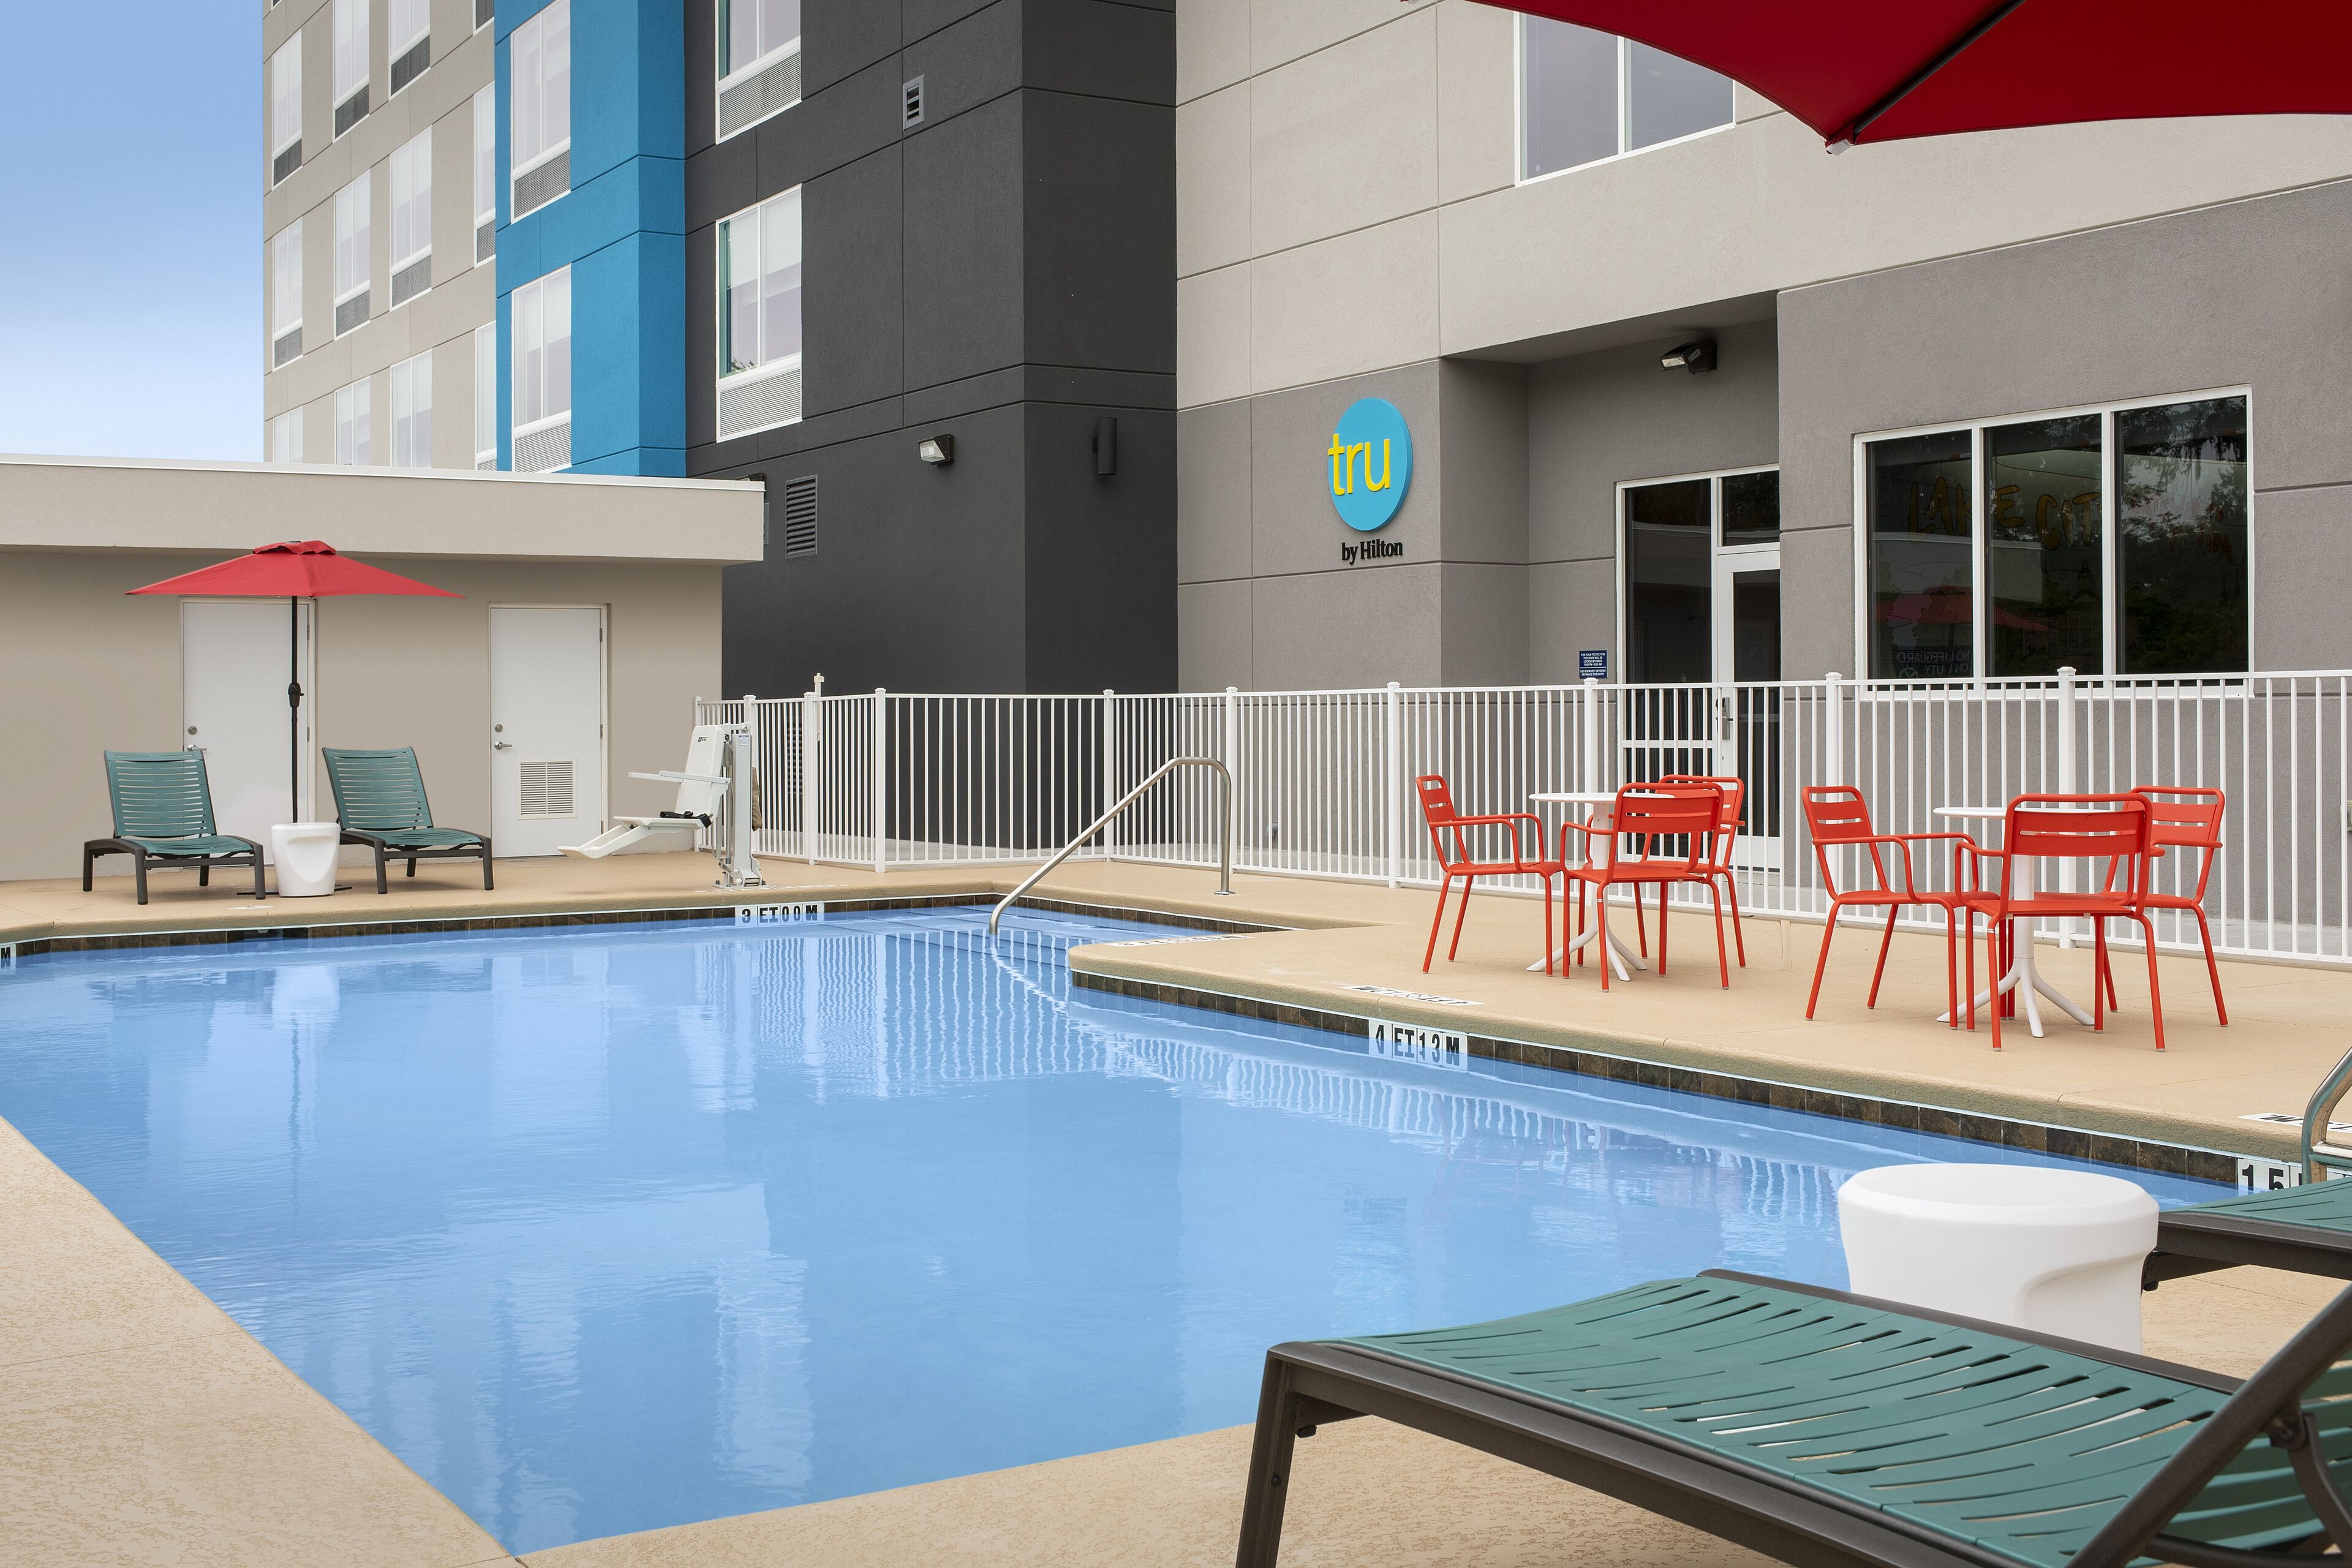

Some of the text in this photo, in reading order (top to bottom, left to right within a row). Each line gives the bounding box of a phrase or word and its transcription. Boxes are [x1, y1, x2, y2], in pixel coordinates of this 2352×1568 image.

[1328, 433, 1391, 496] tru
[2036, 492, 2102, 551] CIT
[1341, 539, 1403, 565] by Hilton
[805, 905, 818, 921] M
[1376, 1025, 1384, 1054] 4
[1446, 1036, 1460, 1066] M
